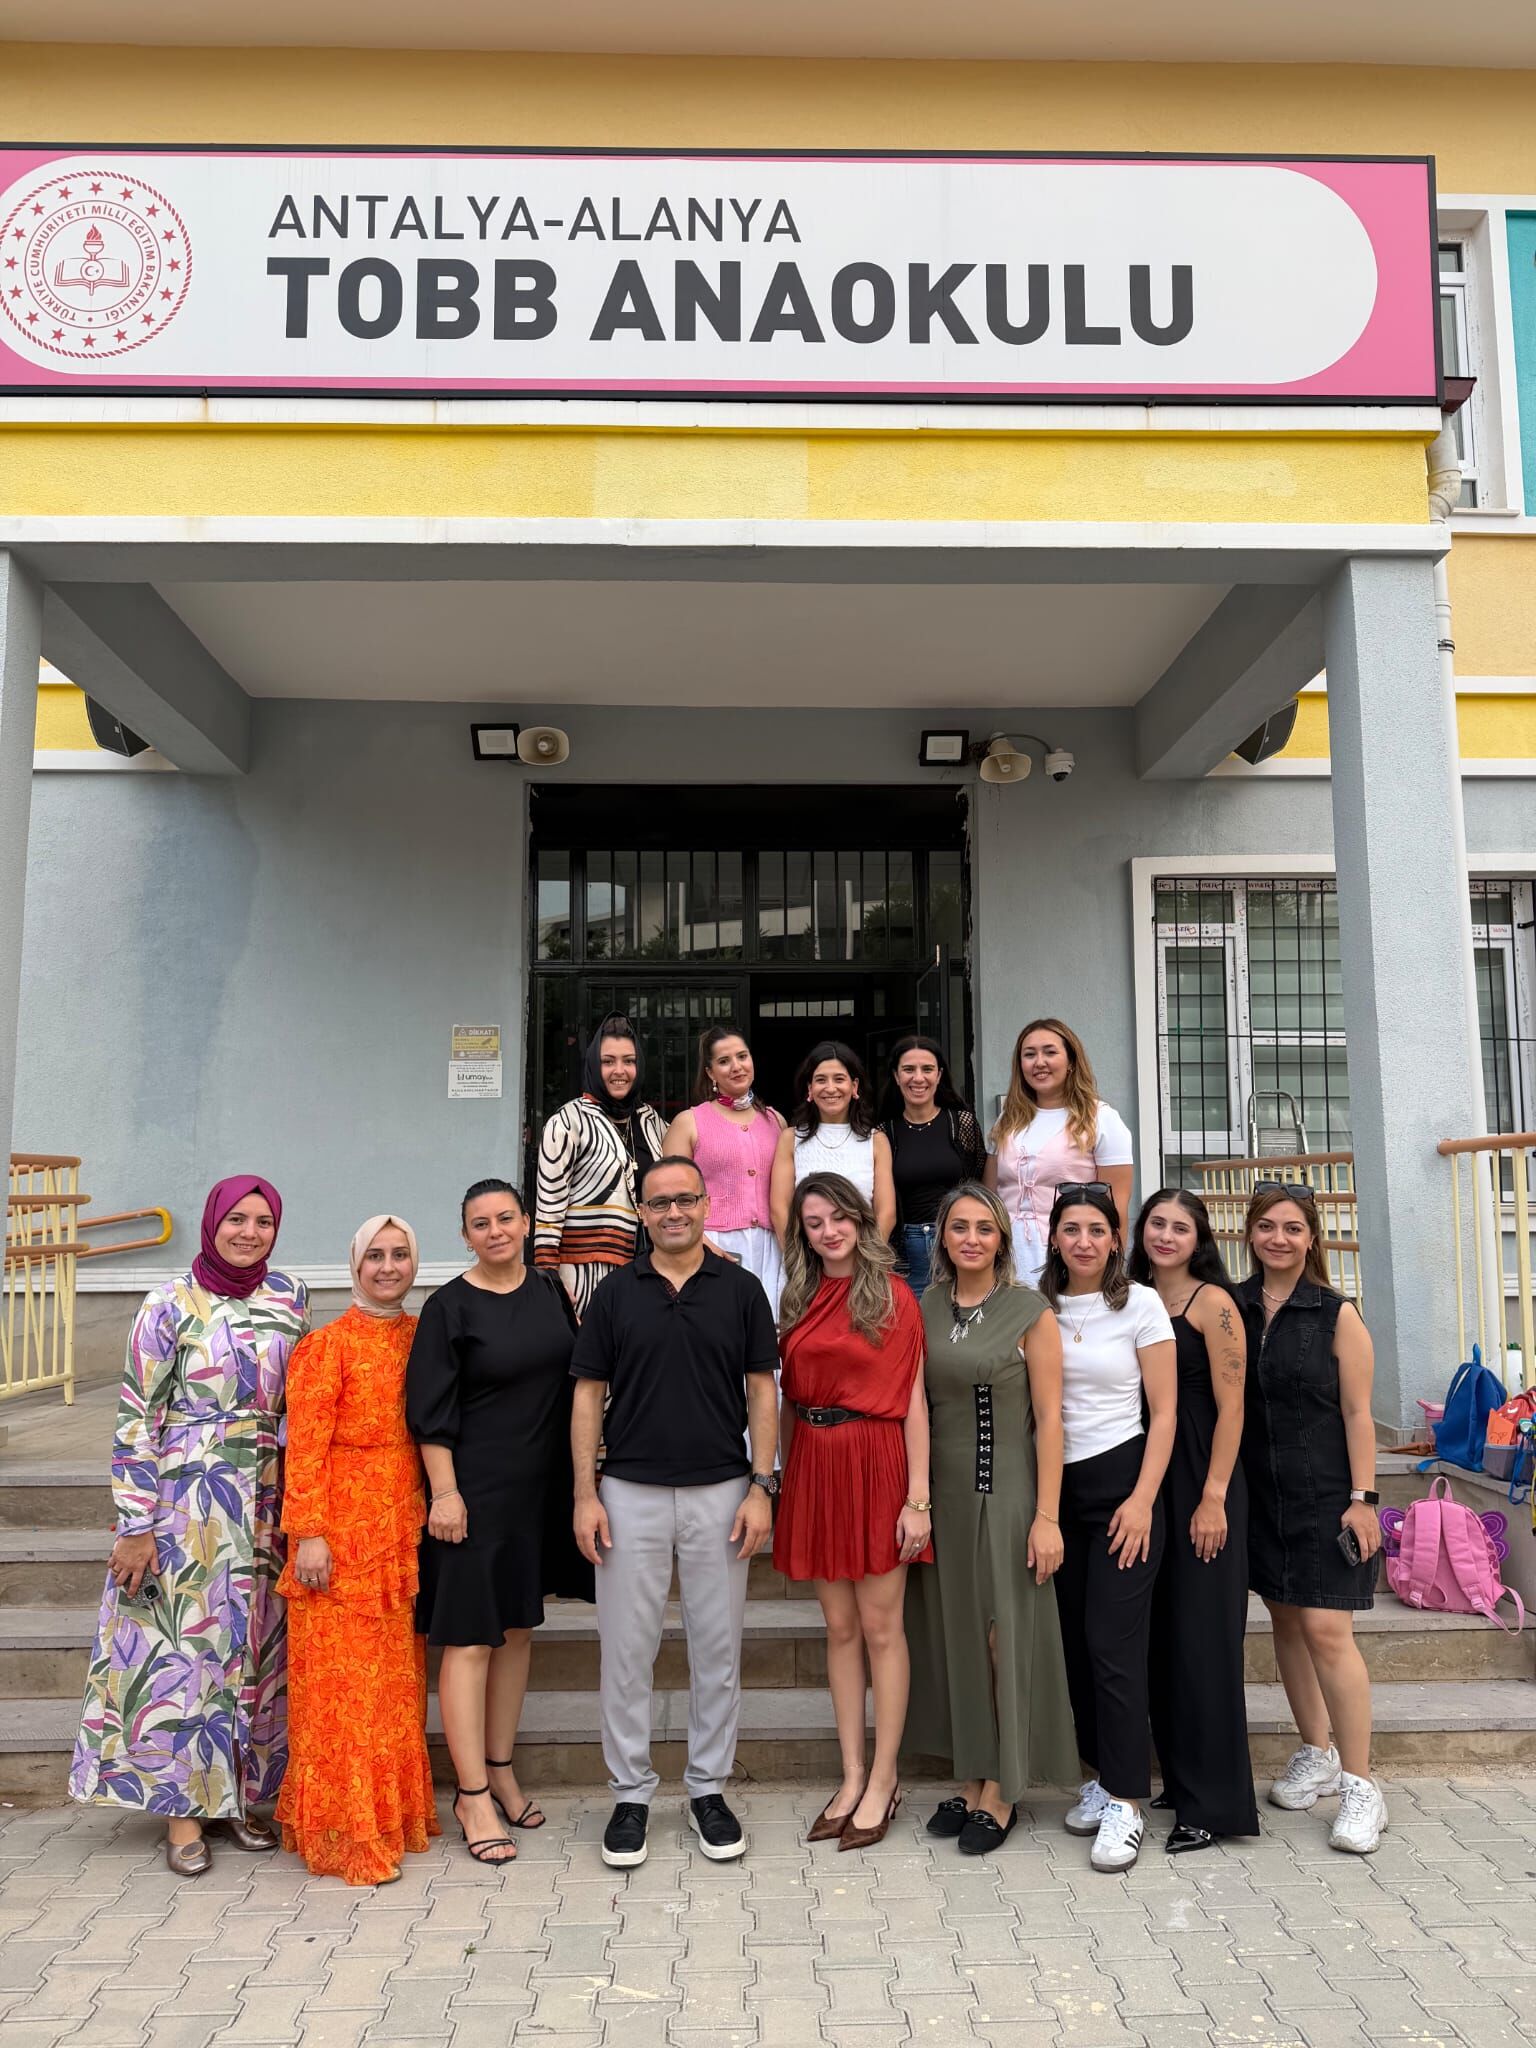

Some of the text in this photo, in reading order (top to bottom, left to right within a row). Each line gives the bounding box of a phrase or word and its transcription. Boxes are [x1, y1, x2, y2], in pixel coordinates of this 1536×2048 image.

[30, 203, 156, 322] TÜRKİYE CUMHURİYETİ MİLLİ EĞİTİM BAKANLIĞI
[268, 194, 802, 243] ANTALYA-ALANYA
[266, 257, 1194, 346] TOBB ANAOKULU
